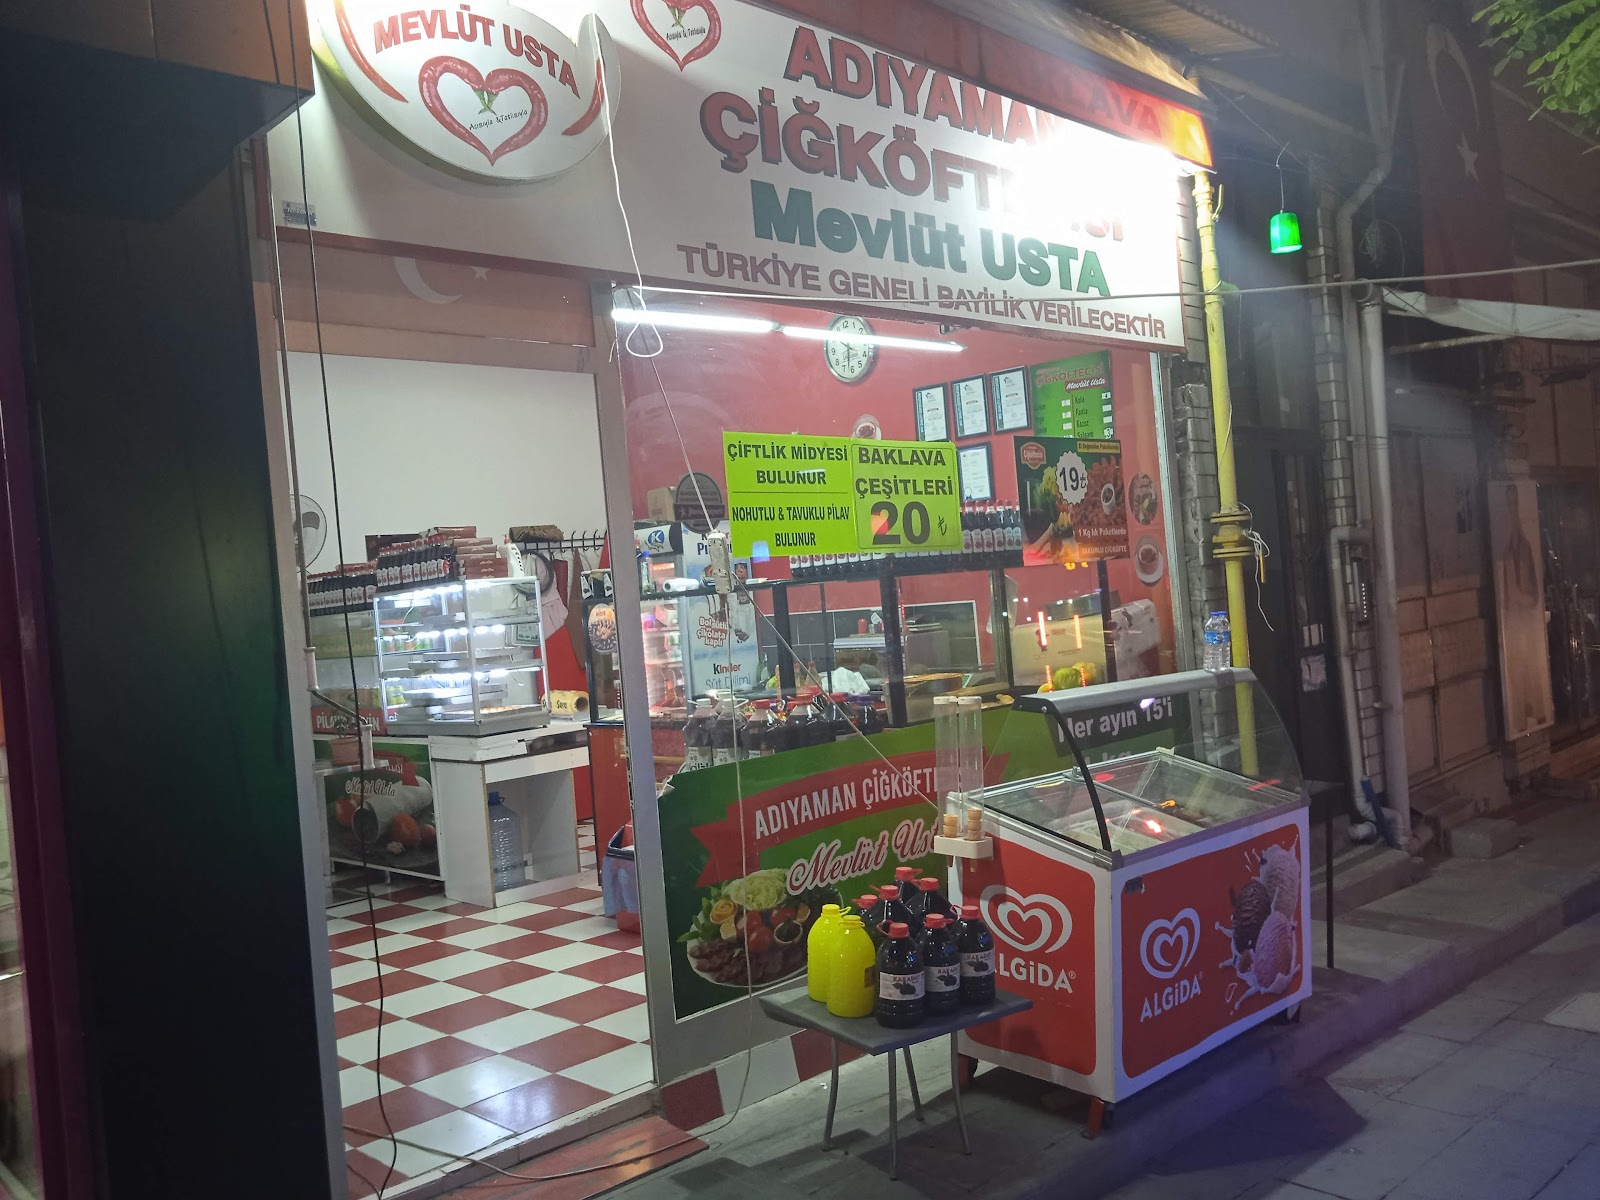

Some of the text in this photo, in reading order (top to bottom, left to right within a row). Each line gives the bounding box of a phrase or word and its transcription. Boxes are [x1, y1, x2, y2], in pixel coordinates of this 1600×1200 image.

[373, 4, 580, 99] MEVLÜT USTA
[750, 179, 1111, 298] Mevlüt USTA
[677, 242, 1167, 339] TÜRKİYE GENELİ BAYİLİK VERİLECEKTİR
[728, 440, 848, 461] ÇİFTLİK MİDYESİ
[858, 447, 946, 466] BAKLAVA
[756, 470, 827, 485] BULUNUR
[855, 475, 954, 499] ÇEŞİTLERİ
[732, 506, 775, 521] NOHUTLU
[778, 507, 785, 521] &
[786, 506, 825, 521] TAVUKLU
[828, 503, 850, 521] PİLAV
[871, 501, 931, 545] 20
[775, 532, 817, 547] BULUNUR
[713, 663, 741, 675] Kinder
[1100, 709, 1137, 736] ayın
[756, 767, 938, 840] ADIYAMAN ÇİĞKÖFT
[787, 819, 939, 893] Mevlüt Ust
